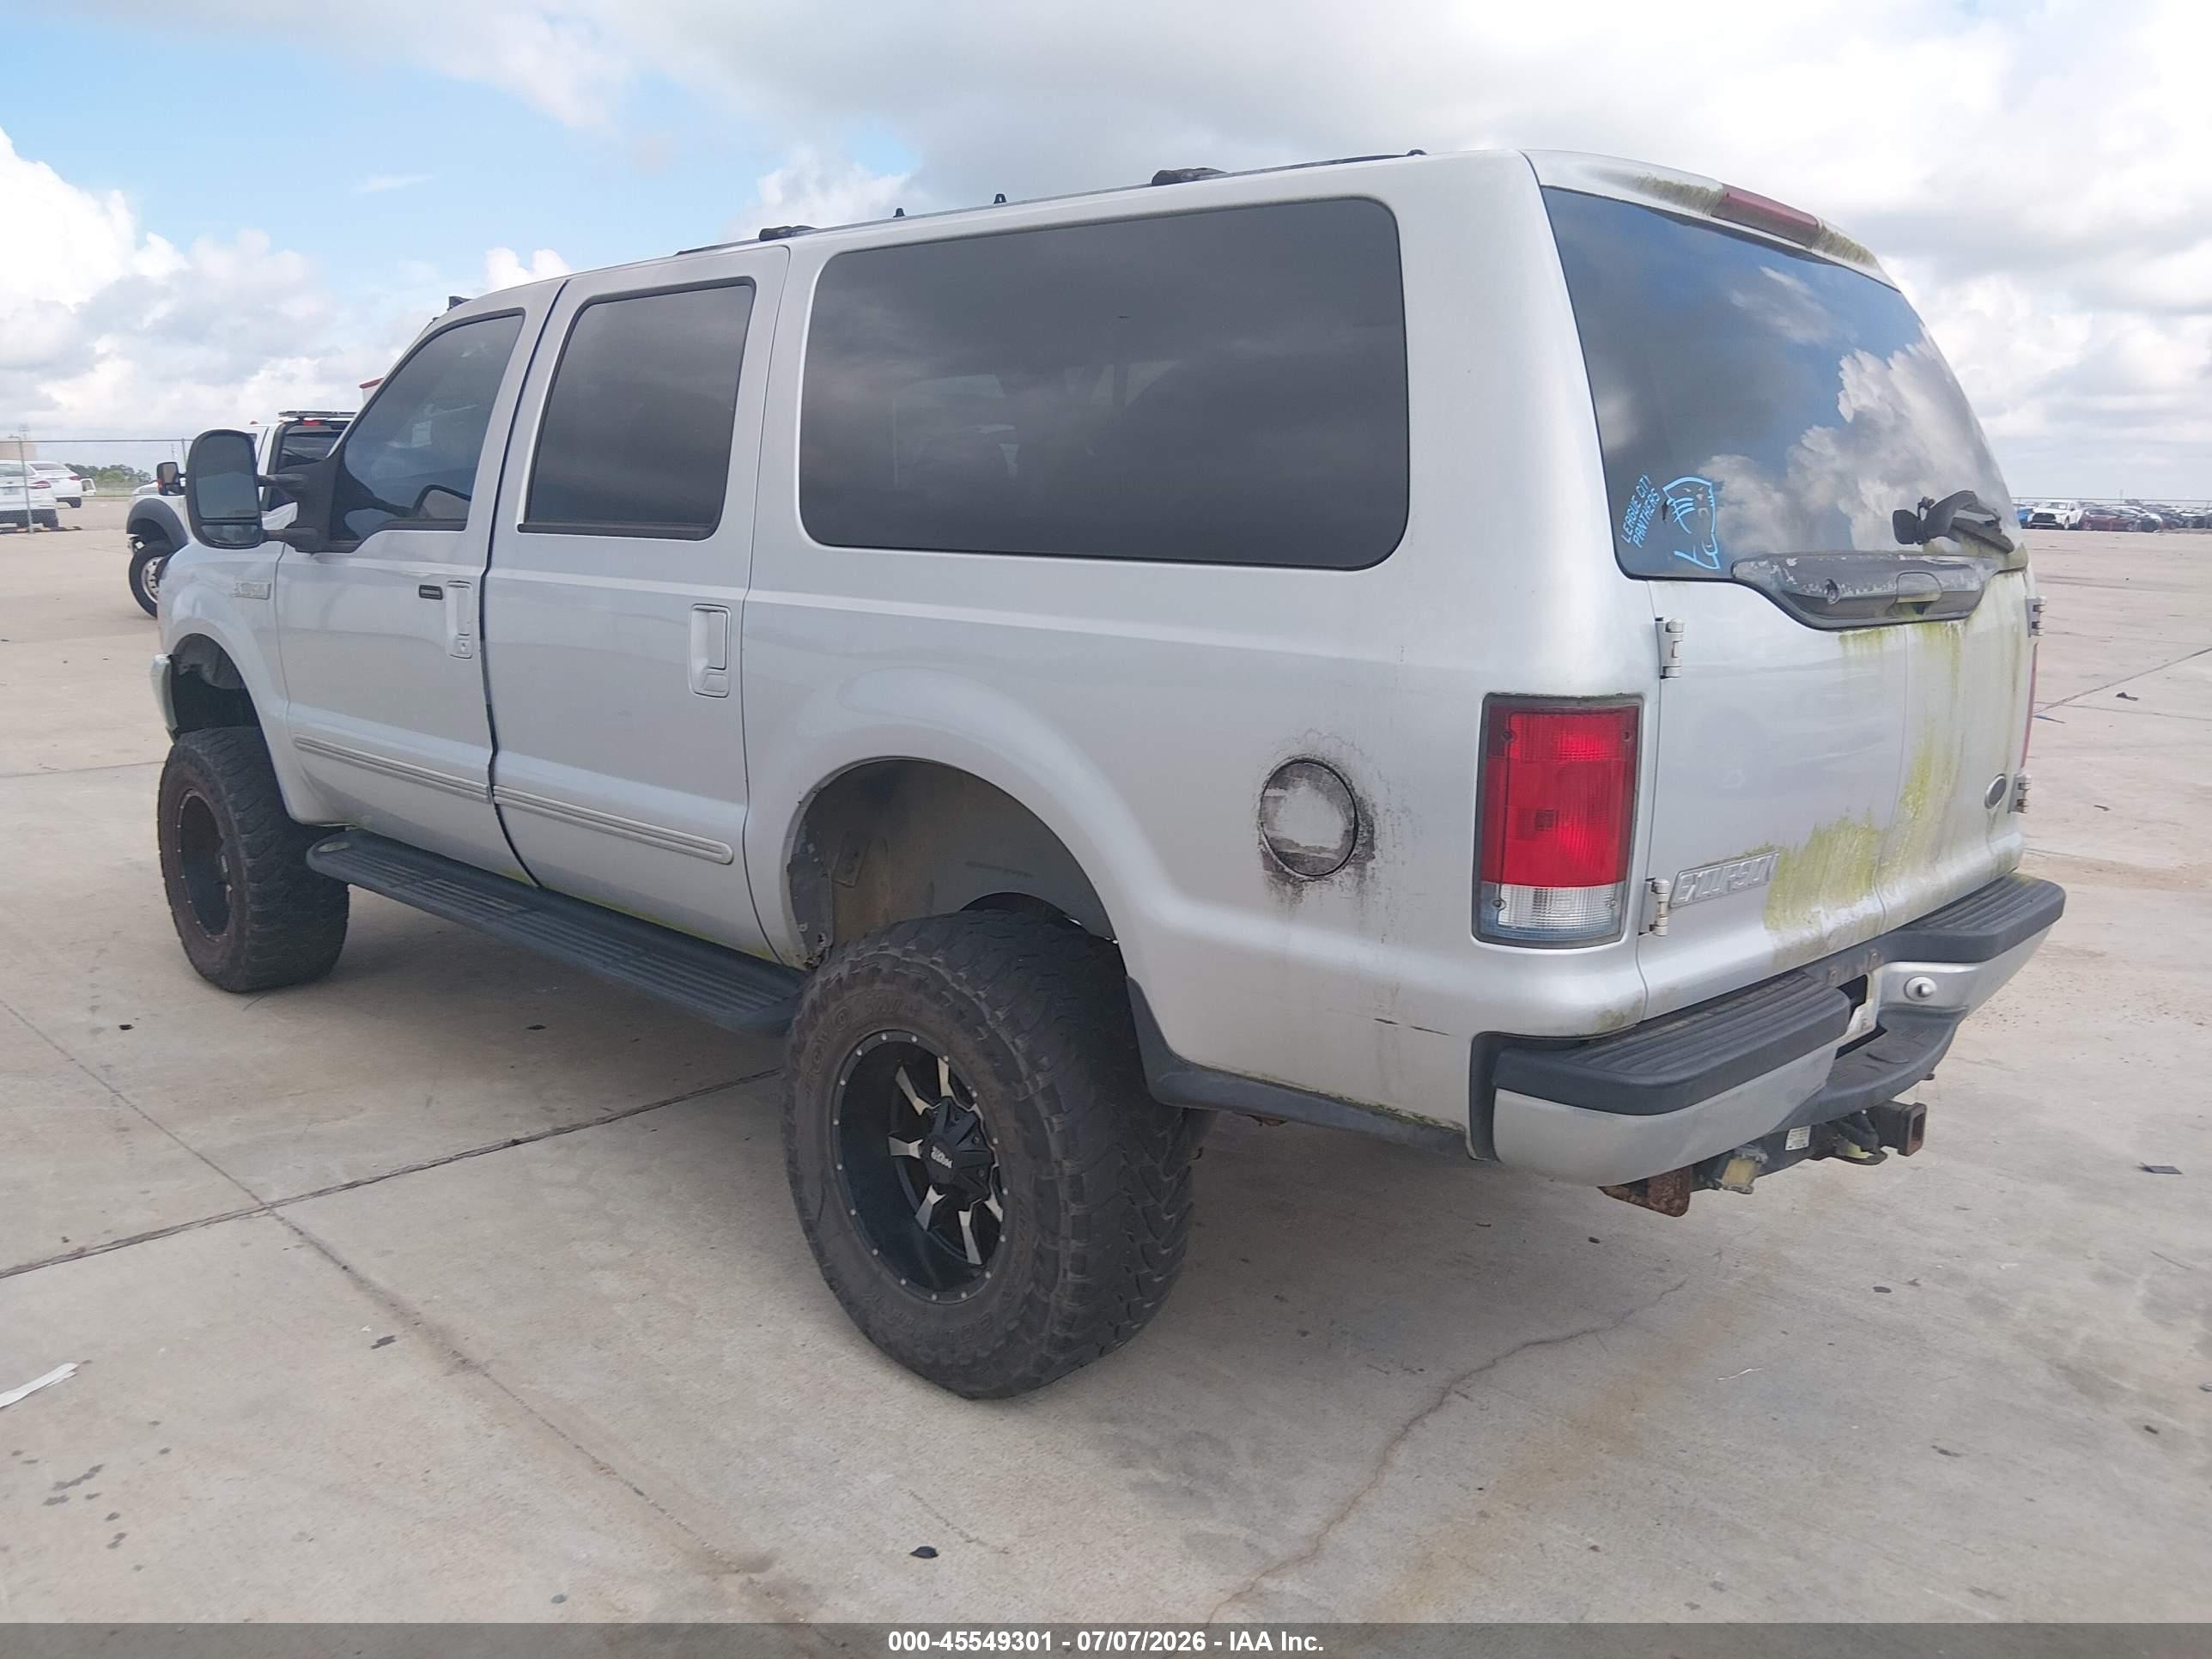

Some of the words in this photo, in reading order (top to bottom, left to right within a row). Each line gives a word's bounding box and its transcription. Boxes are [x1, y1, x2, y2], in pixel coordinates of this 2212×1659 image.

[1621, 495, 1642, 544] LEAGUE
[1636, 474, 1652, 499] CITY
[1632, 488, 1661, 548] PANTHERS
